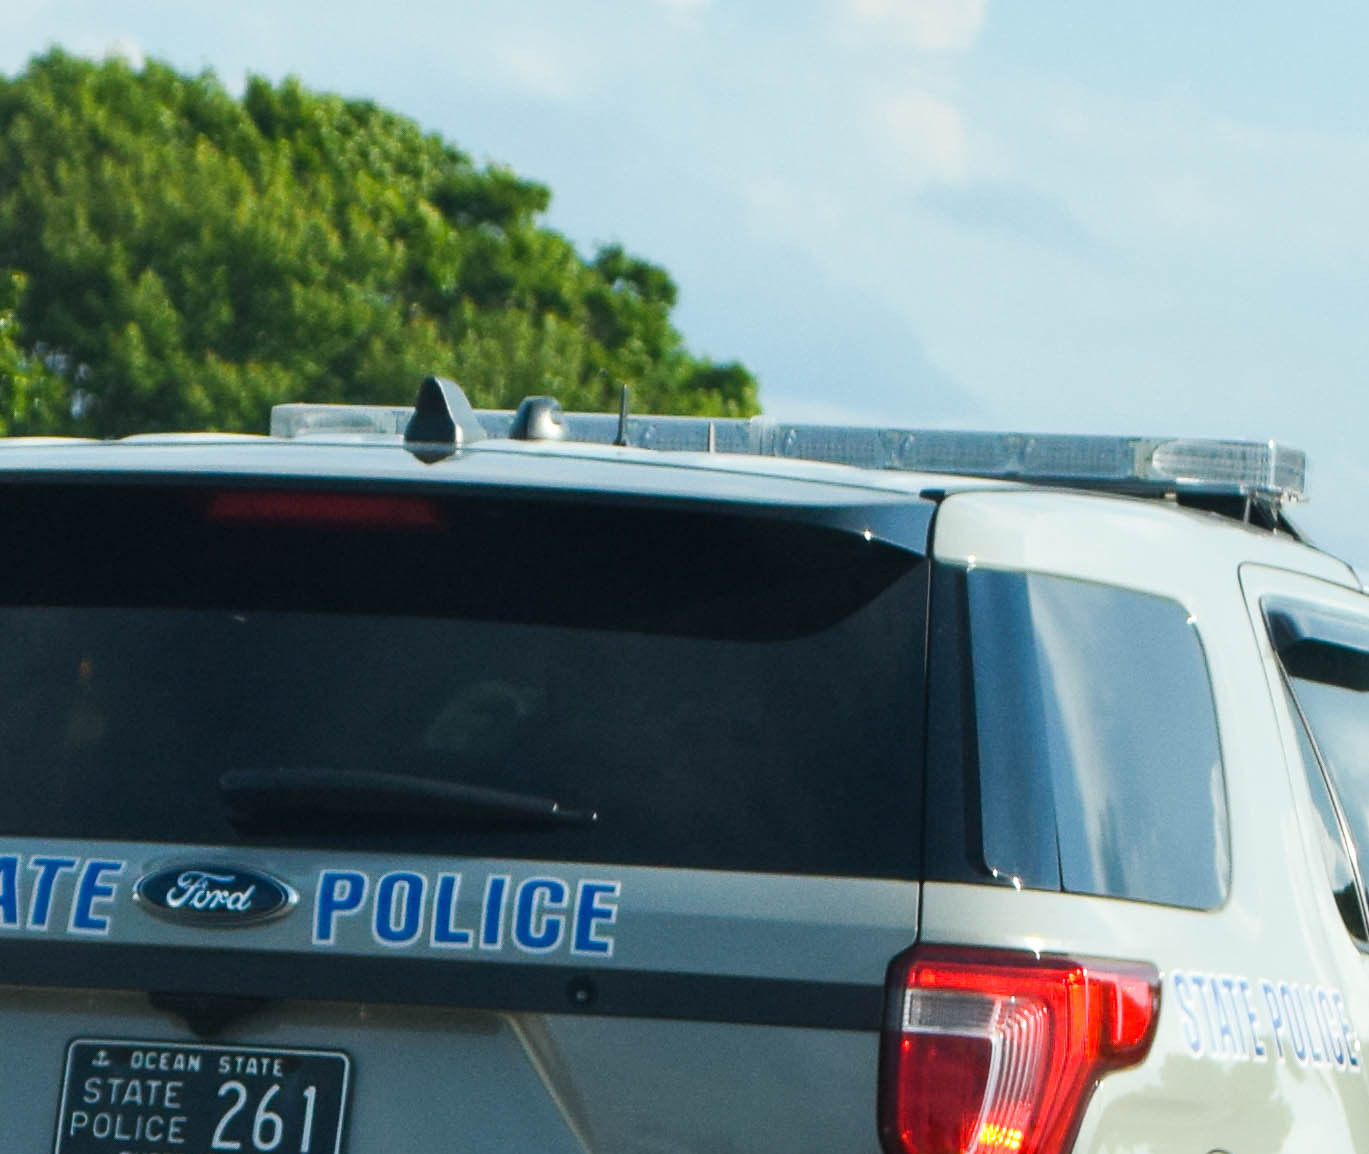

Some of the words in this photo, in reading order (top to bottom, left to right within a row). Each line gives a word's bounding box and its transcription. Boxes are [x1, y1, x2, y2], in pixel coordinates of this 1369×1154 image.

[165, 871, 253, 912] Ford
[312, 869, 621, 958] POLICE
[1172, 969, 1268, 1060] STATE
[1258, 978, 1361, 1072] POLICE
[131, 1051, 201, 1073] OCEAN
[218, 1055, 284, 1077] STATE
[83, 1076, 185, 1109] STATE
[69, 1111, 188, 1145] POLICE
[211, 1080, 318, 1154] 261
